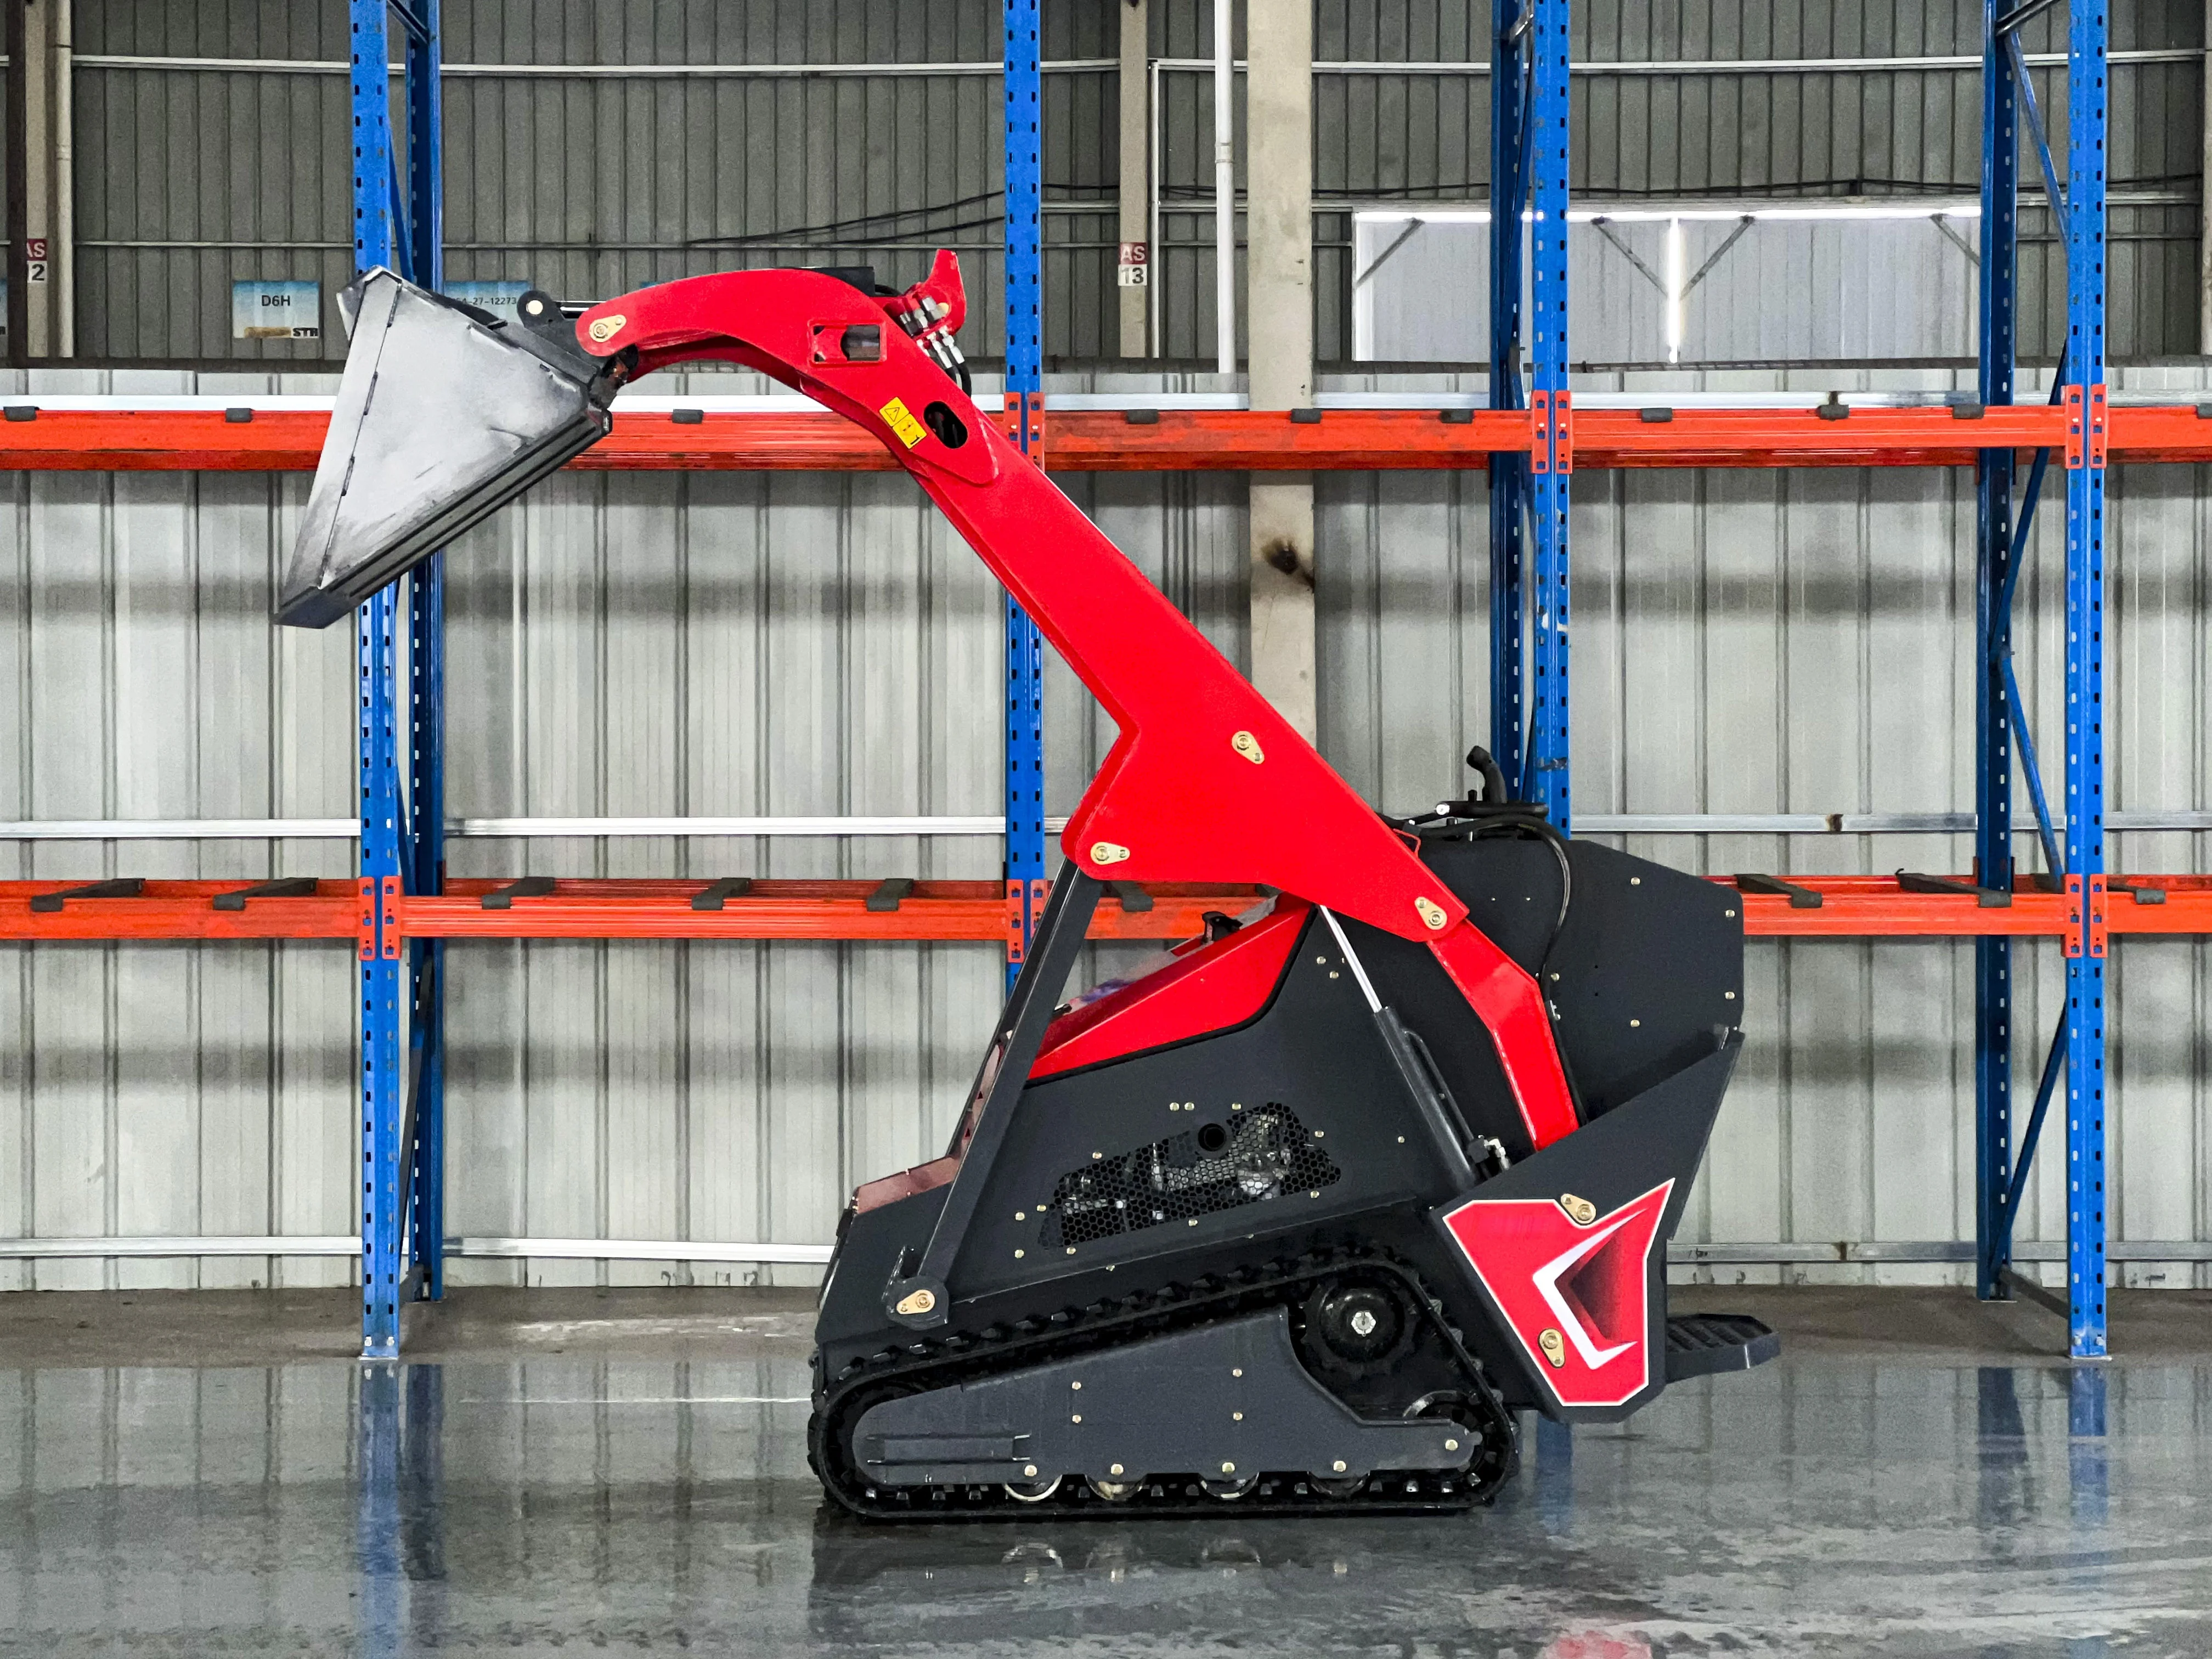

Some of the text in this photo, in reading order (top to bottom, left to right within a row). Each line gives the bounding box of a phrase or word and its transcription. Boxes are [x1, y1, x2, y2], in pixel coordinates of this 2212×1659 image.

[1120, 246, 1146, 261] AS
[1121, 267, 1144, 284] 13
[262, 295, 291, 307] D6H
